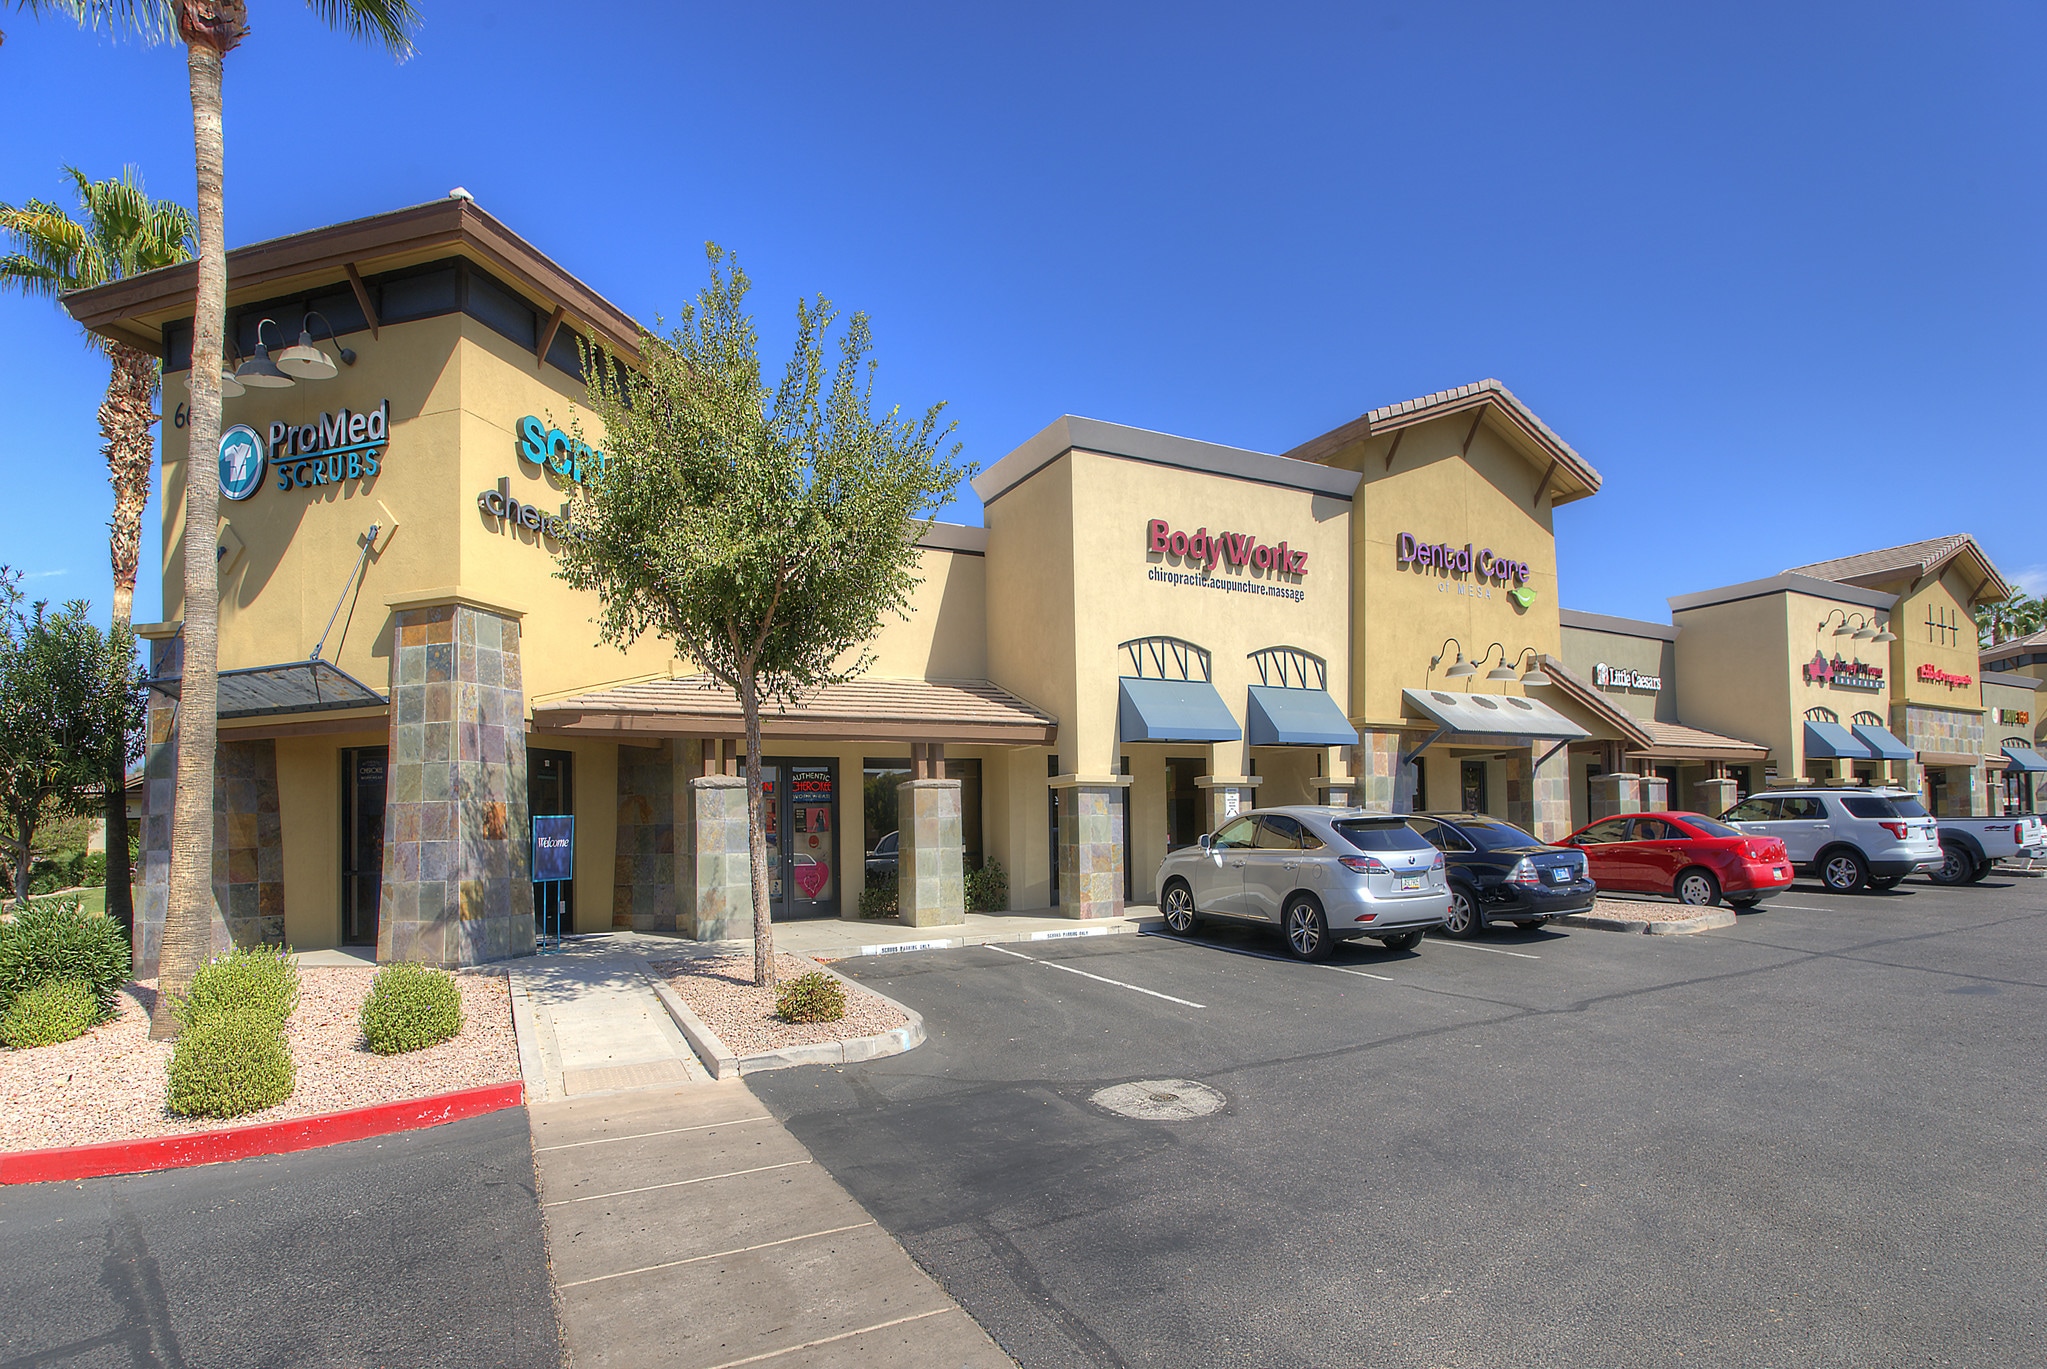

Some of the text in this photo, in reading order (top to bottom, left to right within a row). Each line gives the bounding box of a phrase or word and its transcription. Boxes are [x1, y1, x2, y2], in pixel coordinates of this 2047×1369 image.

[268, 398, 390, 459] ProMed
[276, 448, 381, 491] SCRUBS
[1147, 518, 1309, 575] BodyWorkz
[1397, 531, 1530, 583] Dental Care
[1457, 585, 1492, 600] MESA
[1609, 667, 1662, 691] Little Caesars
[792, 772, 831, 782] AUTHENTIC
[792, 781, 832, 792] CHEROKEE
[537, 836, 570, 849] Welcome
